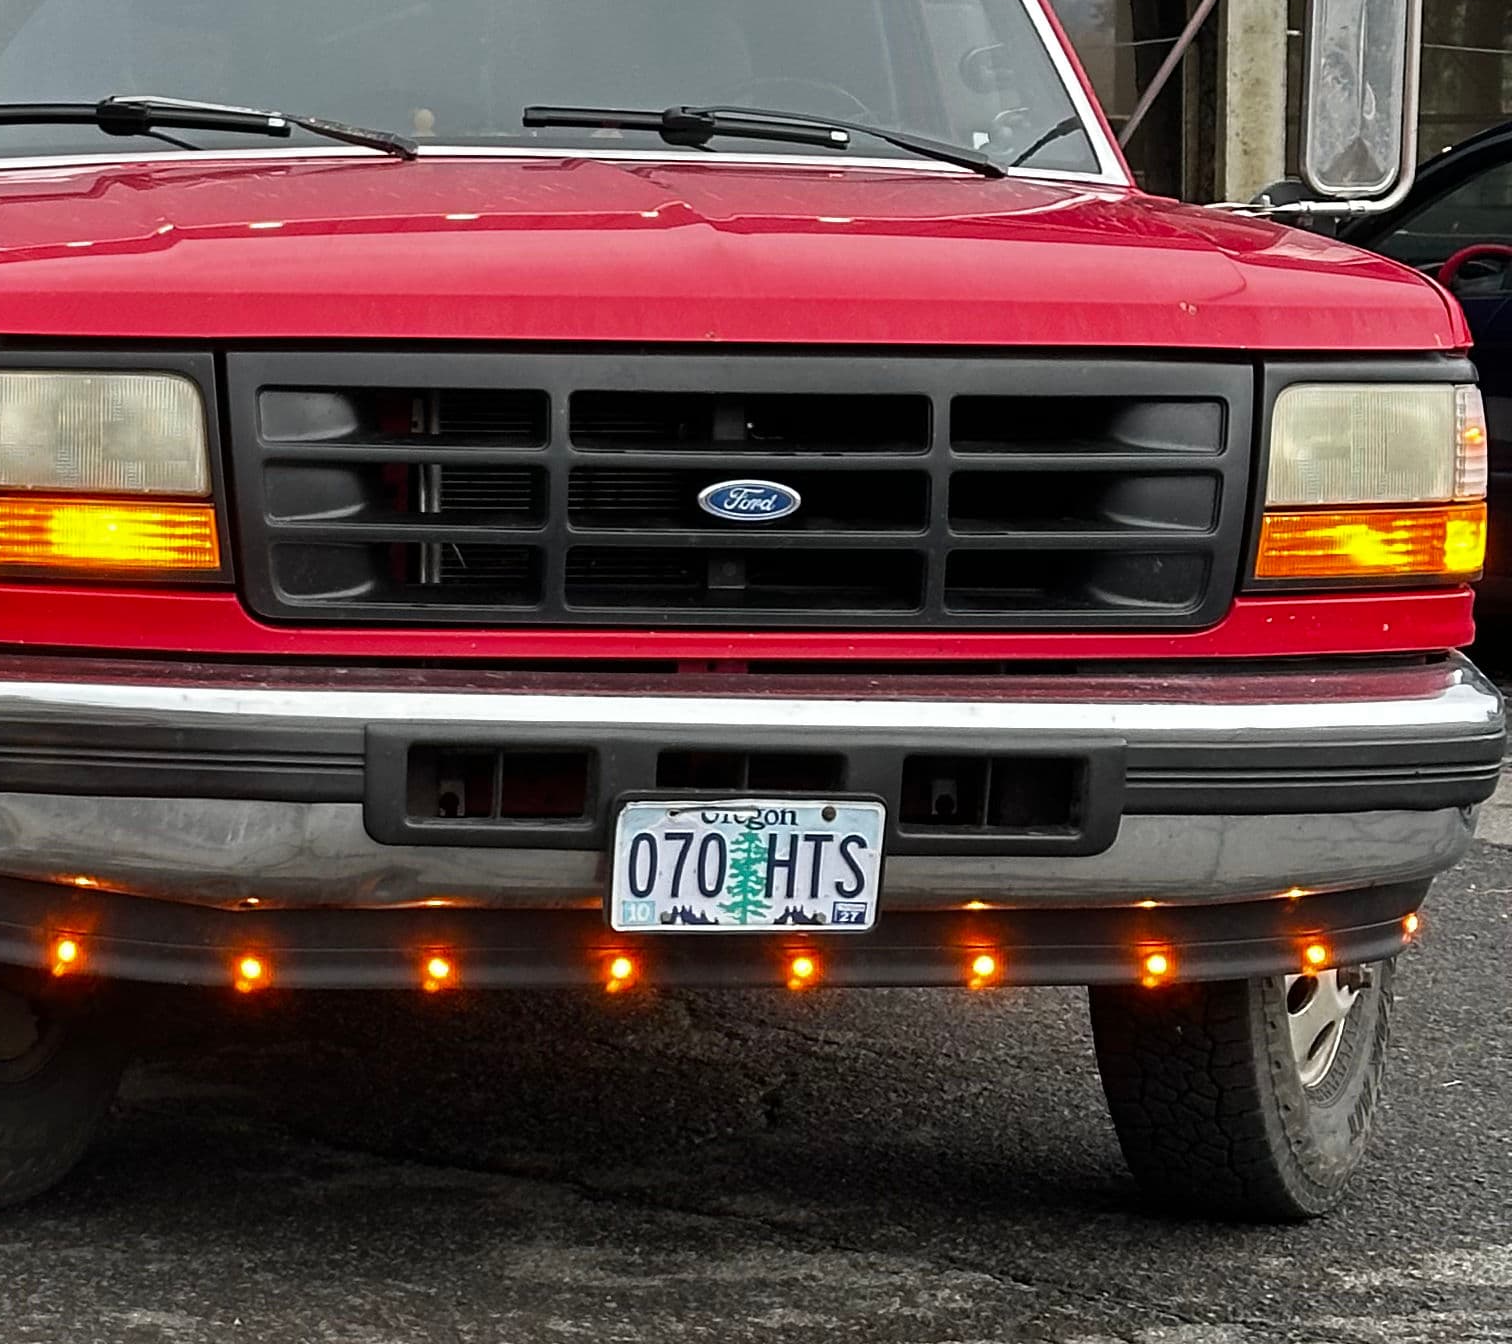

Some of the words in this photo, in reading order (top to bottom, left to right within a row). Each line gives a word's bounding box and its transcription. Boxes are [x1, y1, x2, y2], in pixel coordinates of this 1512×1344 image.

[723, 486, 778, 512] Ford
[627, 831, 728, 900] 070
[763, 832, 868, 900] HTS
[839, 911, 859, 923] 27
